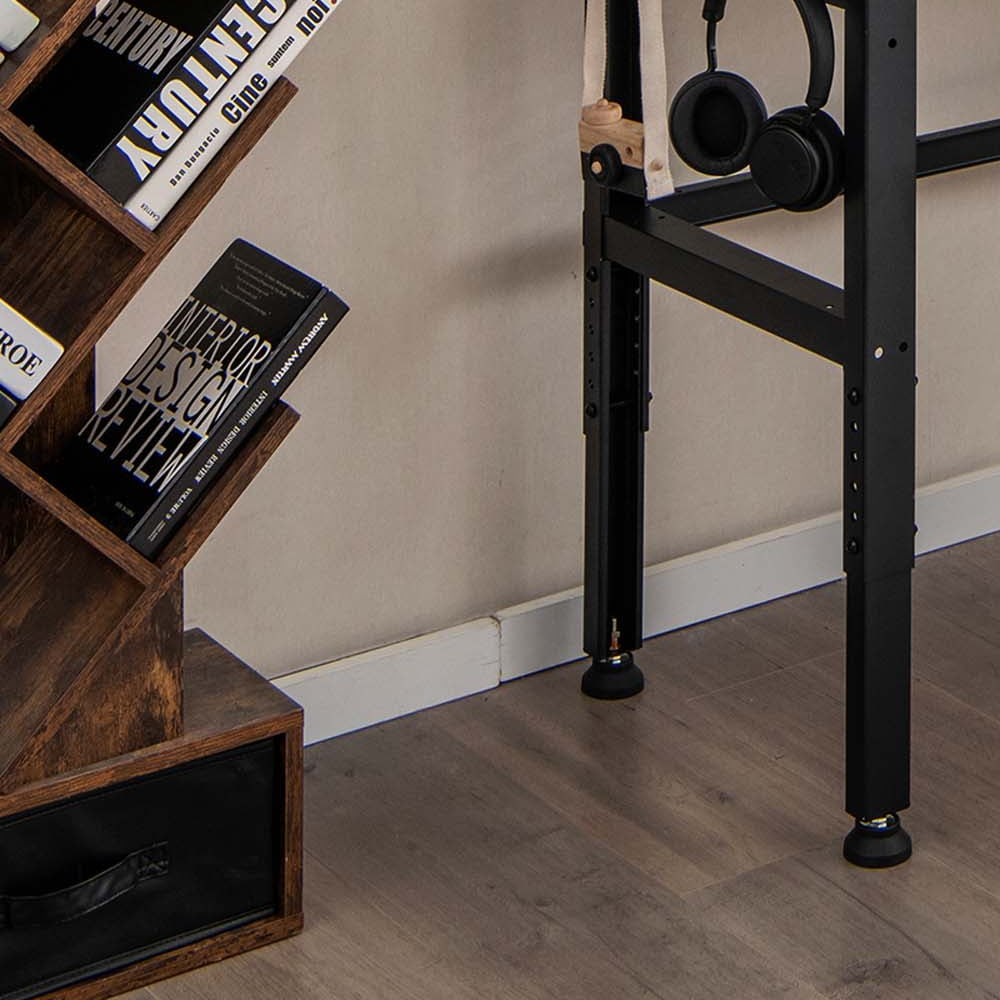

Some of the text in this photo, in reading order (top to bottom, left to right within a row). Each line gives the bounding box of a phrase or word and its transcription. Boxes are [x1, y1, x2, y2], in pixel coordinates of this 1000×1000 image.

[169, 167, 187, 187] Dan
[184, 126, 220, 169] Dungaciu
[220, 71, 269, 126] Cine
[266, 35, 296, 69] suntem
[0, 327, 42, 376] ROE
[163, 296, 272, 389] INTERIOR
[298, 312, 329, 354] ANDREW
[123, 331, 249, 438] DESIGN
[271, 350, 299, 387] MARTIN
[238, 389, 269, 427] INTERIOR
[78, 385, 208, 494] REVIEW
[217, 425, 241, 454] DESIGN
[195, 454, 219, 484] REVIEW
[171, 487, 193, 514] VOLUME
